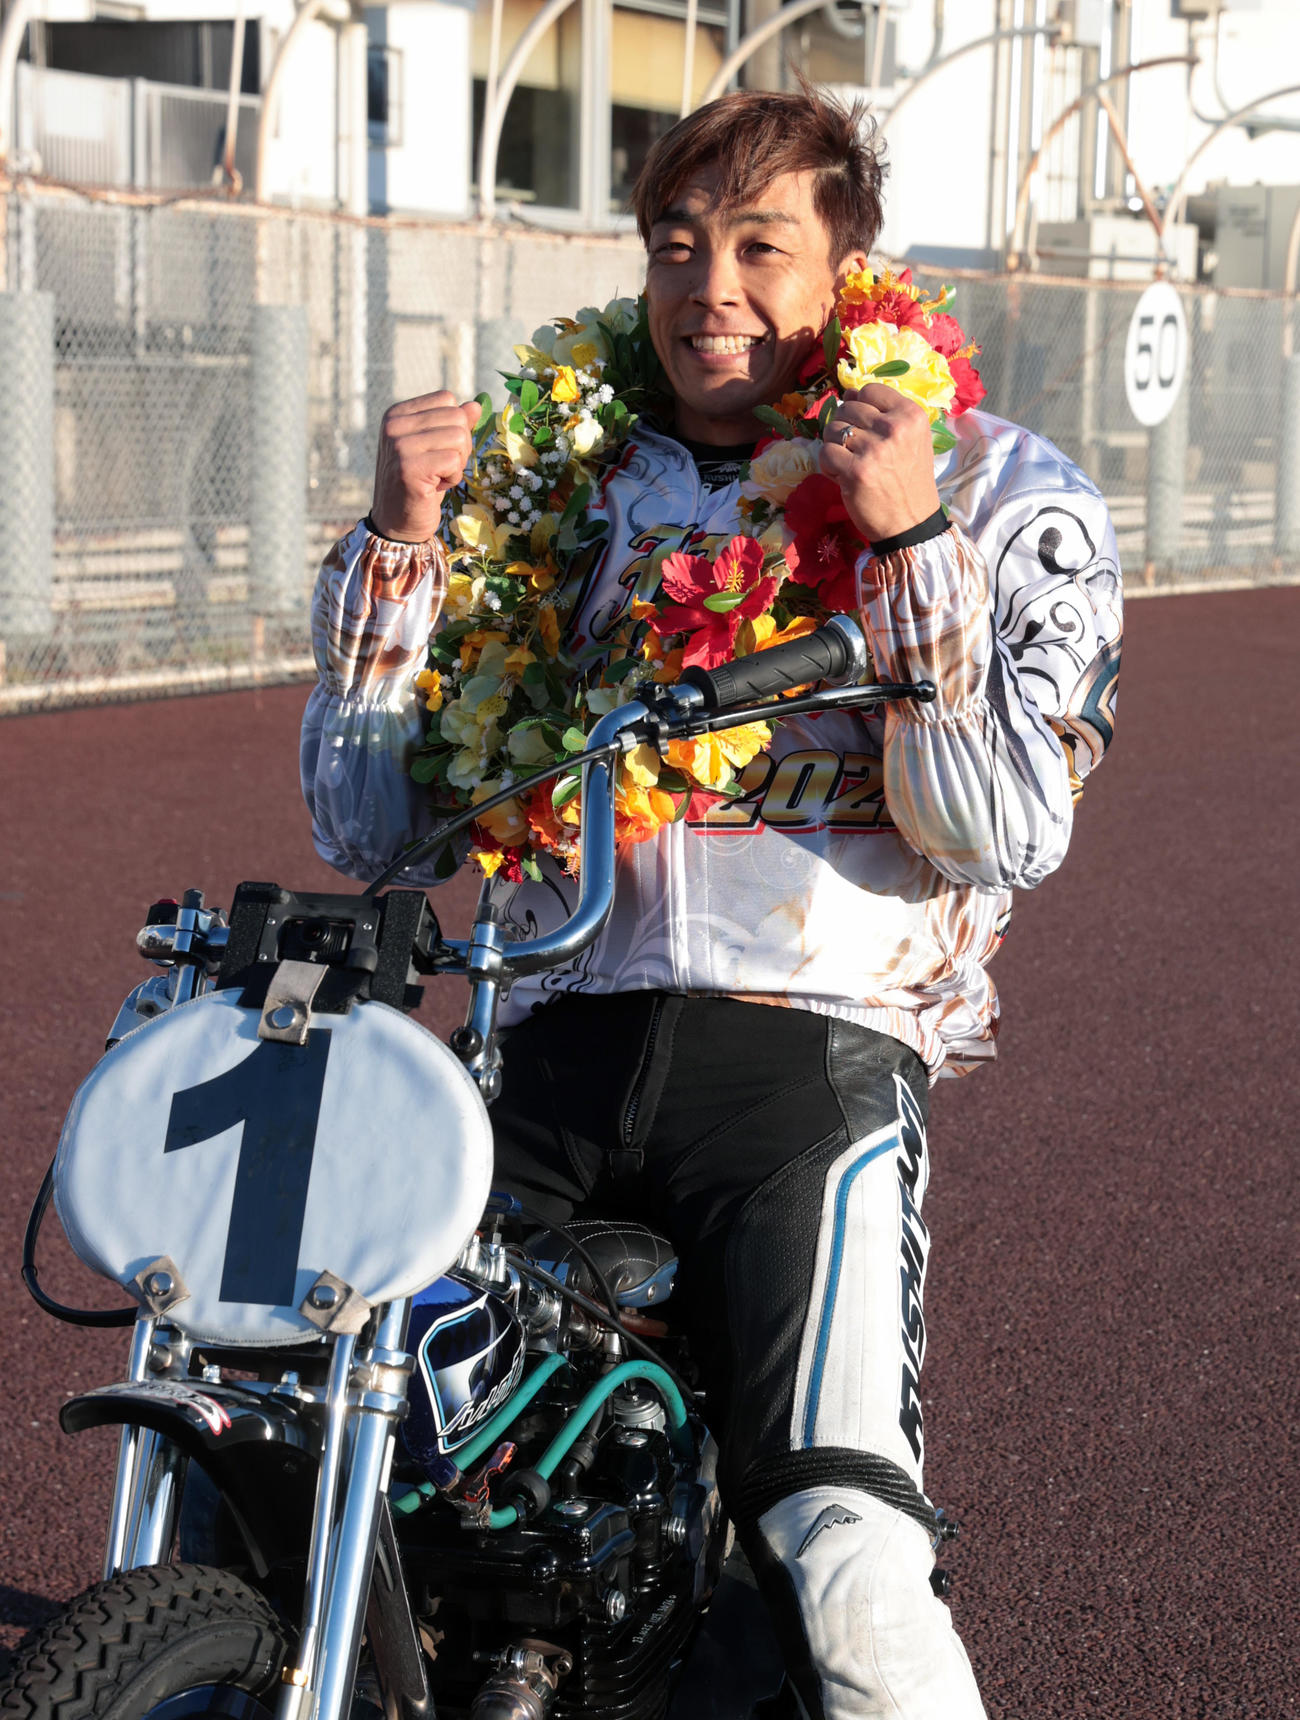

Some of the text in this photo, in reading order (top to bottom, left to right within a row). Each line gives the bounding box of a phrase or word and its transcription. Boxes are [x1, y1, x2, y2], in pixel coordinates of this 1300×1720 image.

[1135, 314, 1178, 390] 50
[686, 749, 898, 832] 202
[163, 1028, 332, 1306] 1
